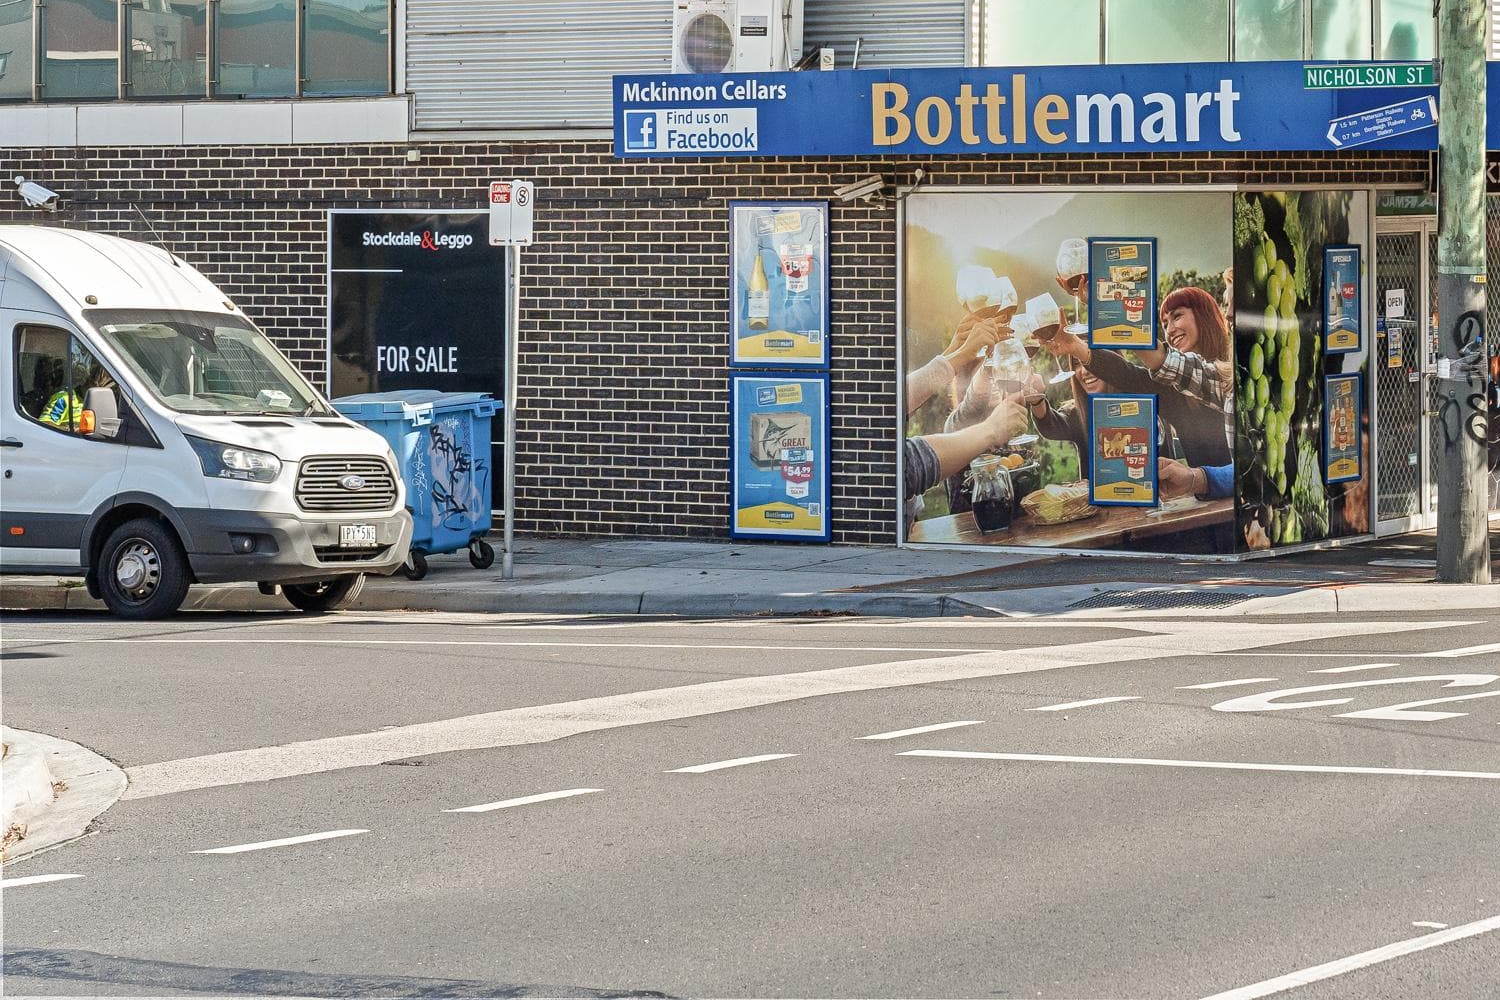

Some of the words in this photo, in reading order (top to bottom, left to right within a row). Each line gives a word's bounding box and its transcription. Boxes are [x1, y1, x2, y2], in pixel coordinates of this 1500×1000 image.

[1307, 68, 1396, 86] NICHOLSON
[1407, 67, 1425, 84] ST
[623, 81, 717, 102] Mckinnon
[721, 80, 787, 100] Cellars
[667, 110, 693, 125] Find
[696, 113, 710, 124] us
[713, 113, 729, 124] on
[870, 73, 1242, 146] Bottlemart
[1349, 119, 1358, 127] km
[1385, 107, 1404, 117] Railway
[1376, 116, 1393, 124] Station
[1387, 118, 1406, 127] Railway
[668, 128, 755, 149] Facebook
[1377, 128, 1394, 137] Station
[1388, 298, 1403, 307] OPEN
[377, 346, 410, 372] FOR
[415, 346, 458, 373] SALE
[782, 437, 806, 447] GREAT
